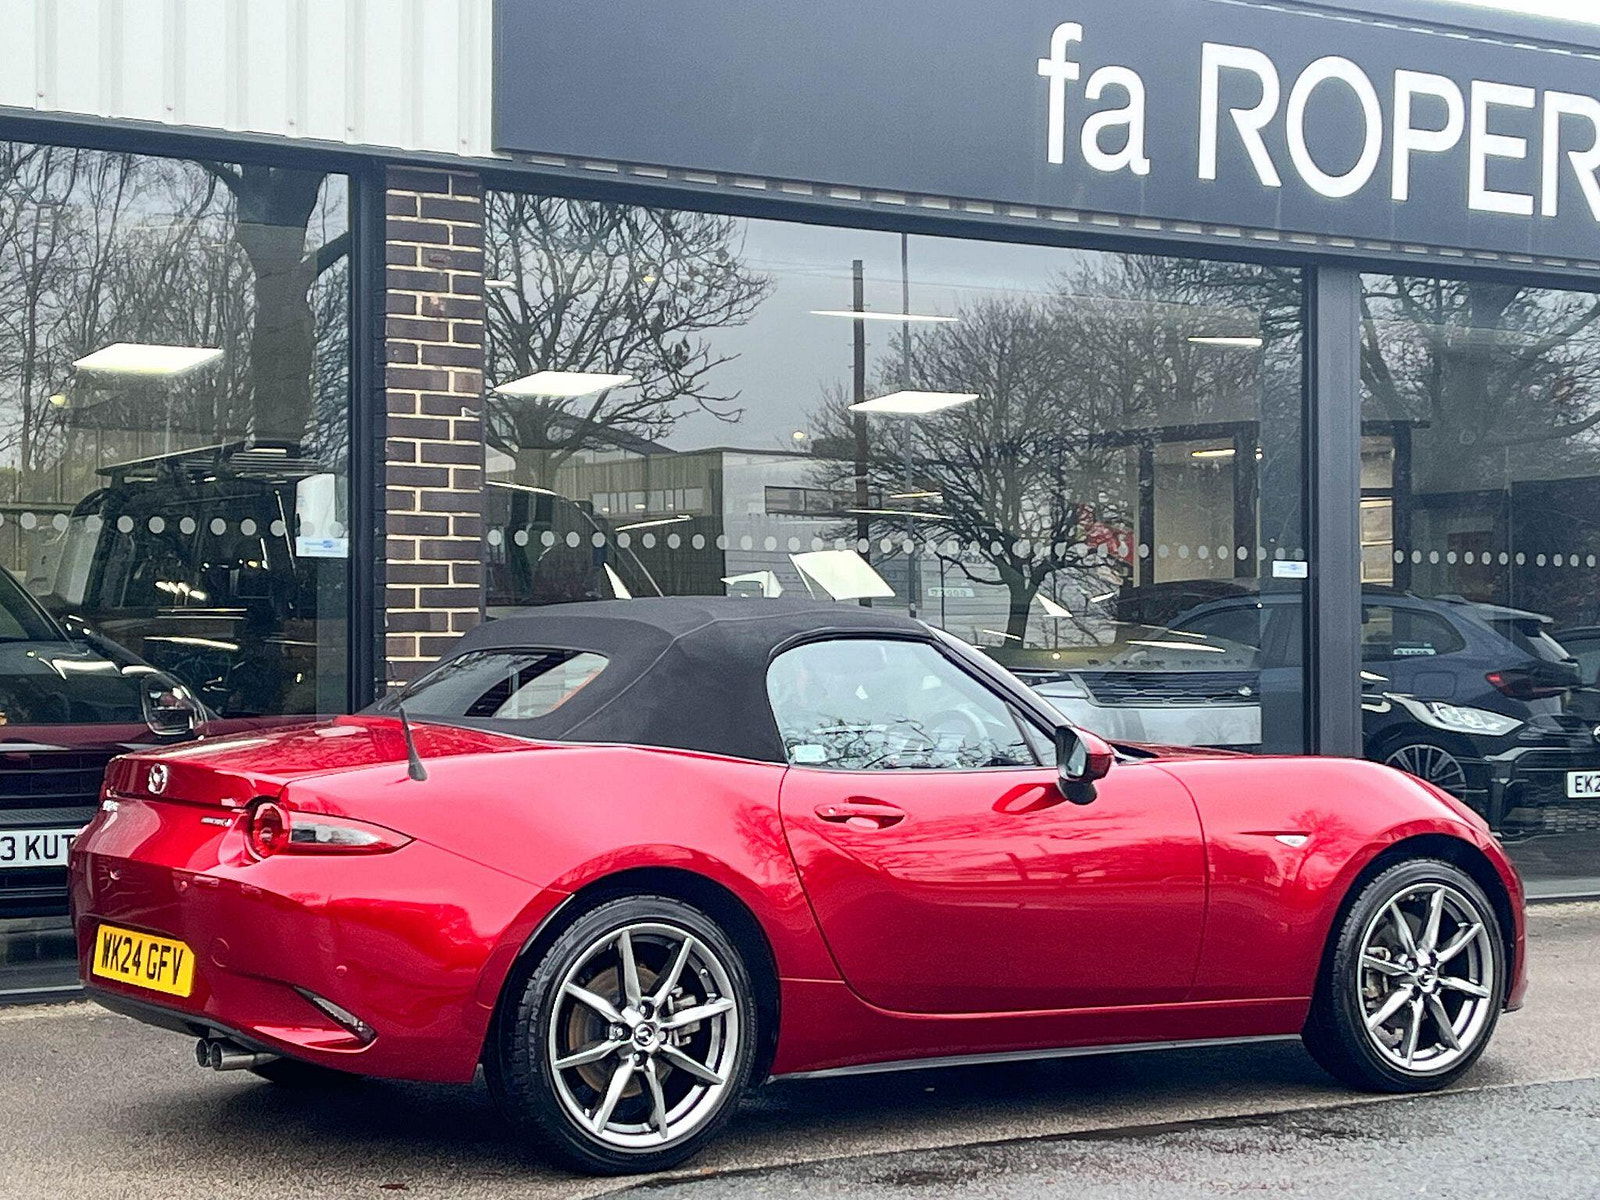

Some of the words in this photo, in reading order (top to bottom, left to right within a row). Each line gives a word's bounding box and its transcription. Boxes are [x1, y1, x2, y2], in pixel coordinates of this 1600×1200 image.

[1037, 21, 1151, 176] fa
[1199, 41, 1600, 223] ROPER
[25, 834, 76, 860] KUT
[101, 931, 142, 977] WK24
[146, 942, 184, 986] GFV
